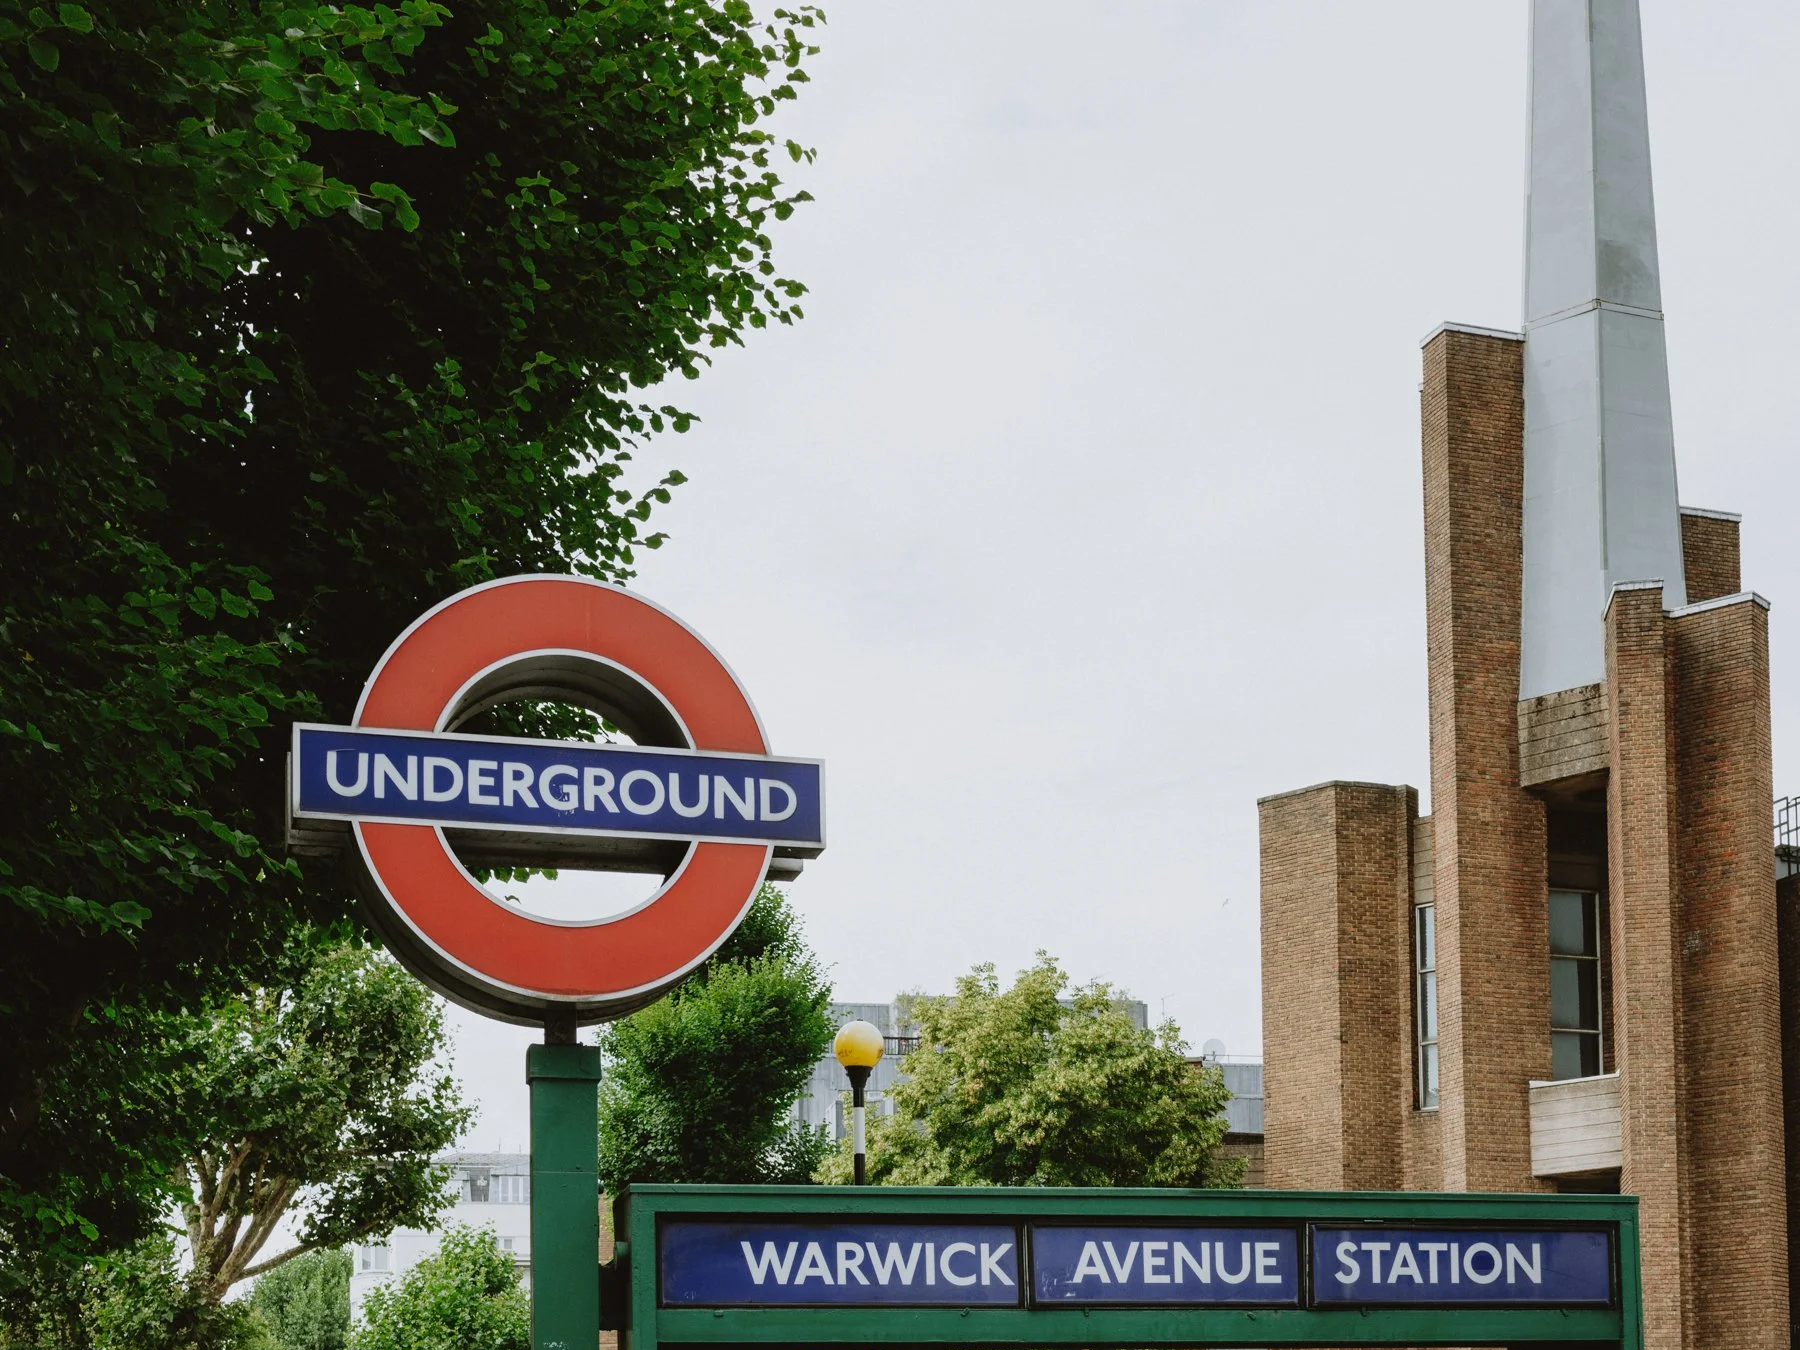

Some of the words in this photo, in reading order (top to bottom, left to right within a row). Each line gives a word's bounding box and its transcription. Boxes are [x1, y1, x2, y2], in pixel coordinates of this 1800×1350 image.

[325, 750, 798, 823] UNDERGROUND
[740, 1240, 1015, 1286] WARWICK
[1072, 1240, 1283, 1285] AVENUE
[1333, 1240, 1543, 1285] STATION
